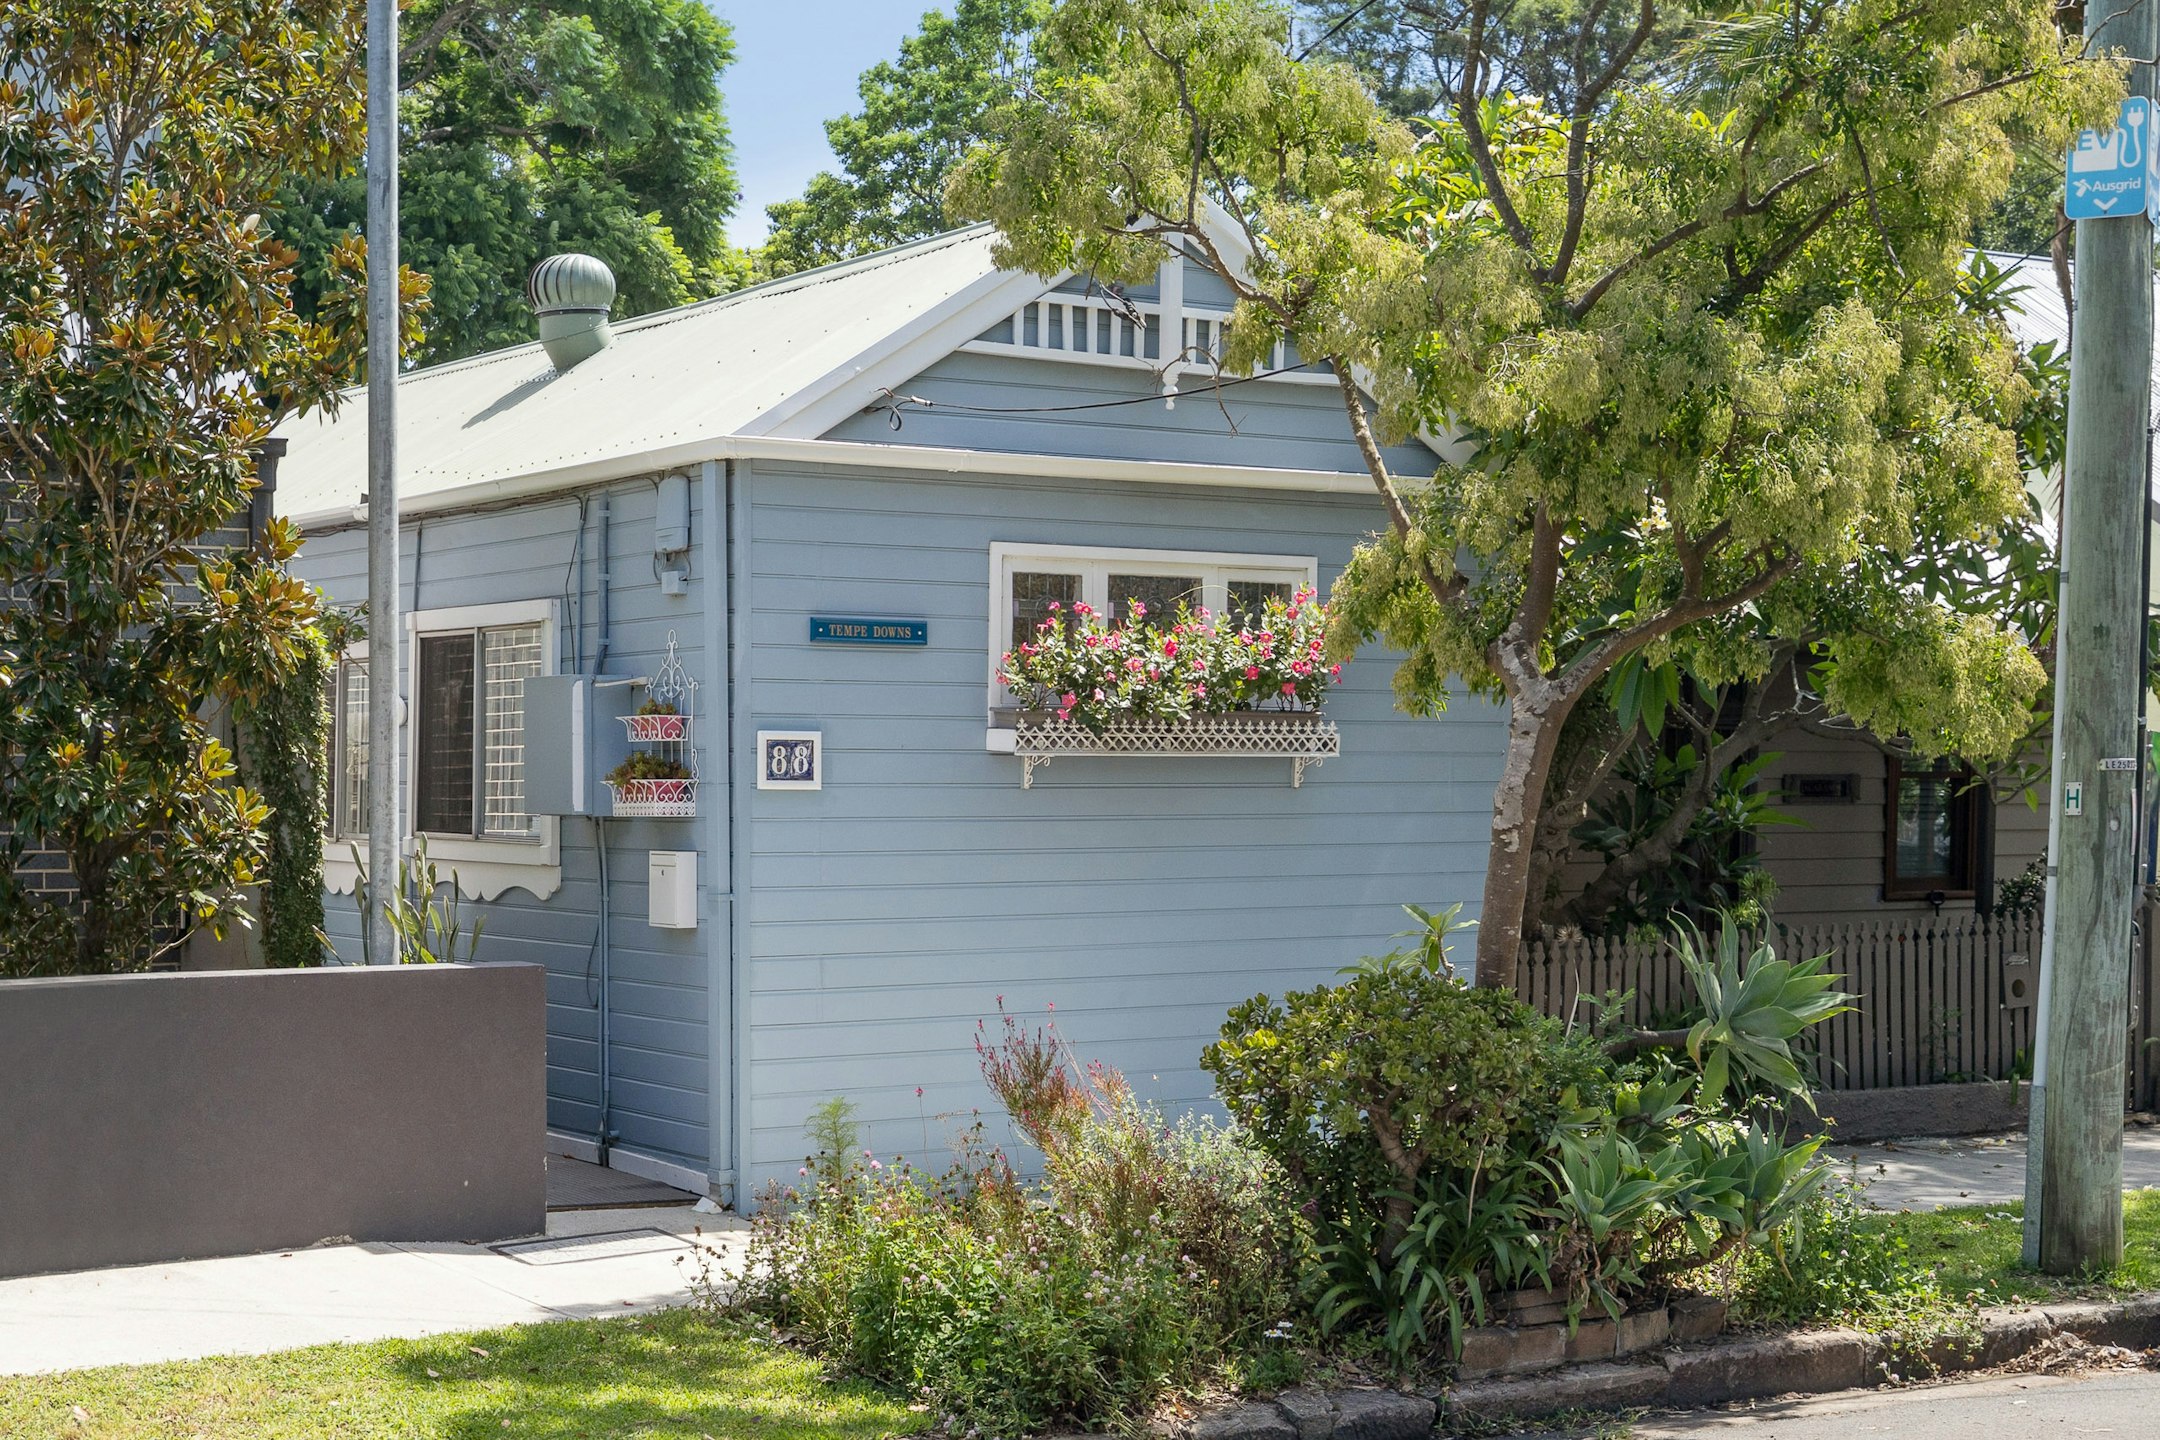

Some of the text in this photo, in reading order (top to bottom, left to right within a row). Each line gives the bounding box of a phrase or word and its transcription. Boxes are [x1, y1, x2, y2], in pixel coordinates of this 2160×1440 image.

[2077, 129, 2117, 151] EV
[2092, 177, 2141, 193] Ausgrid
[828, 624, 912, 638] TEMPE DOWNS
[771, 745, 809, 774] 88
[2066, 788, 2080, 809] H
